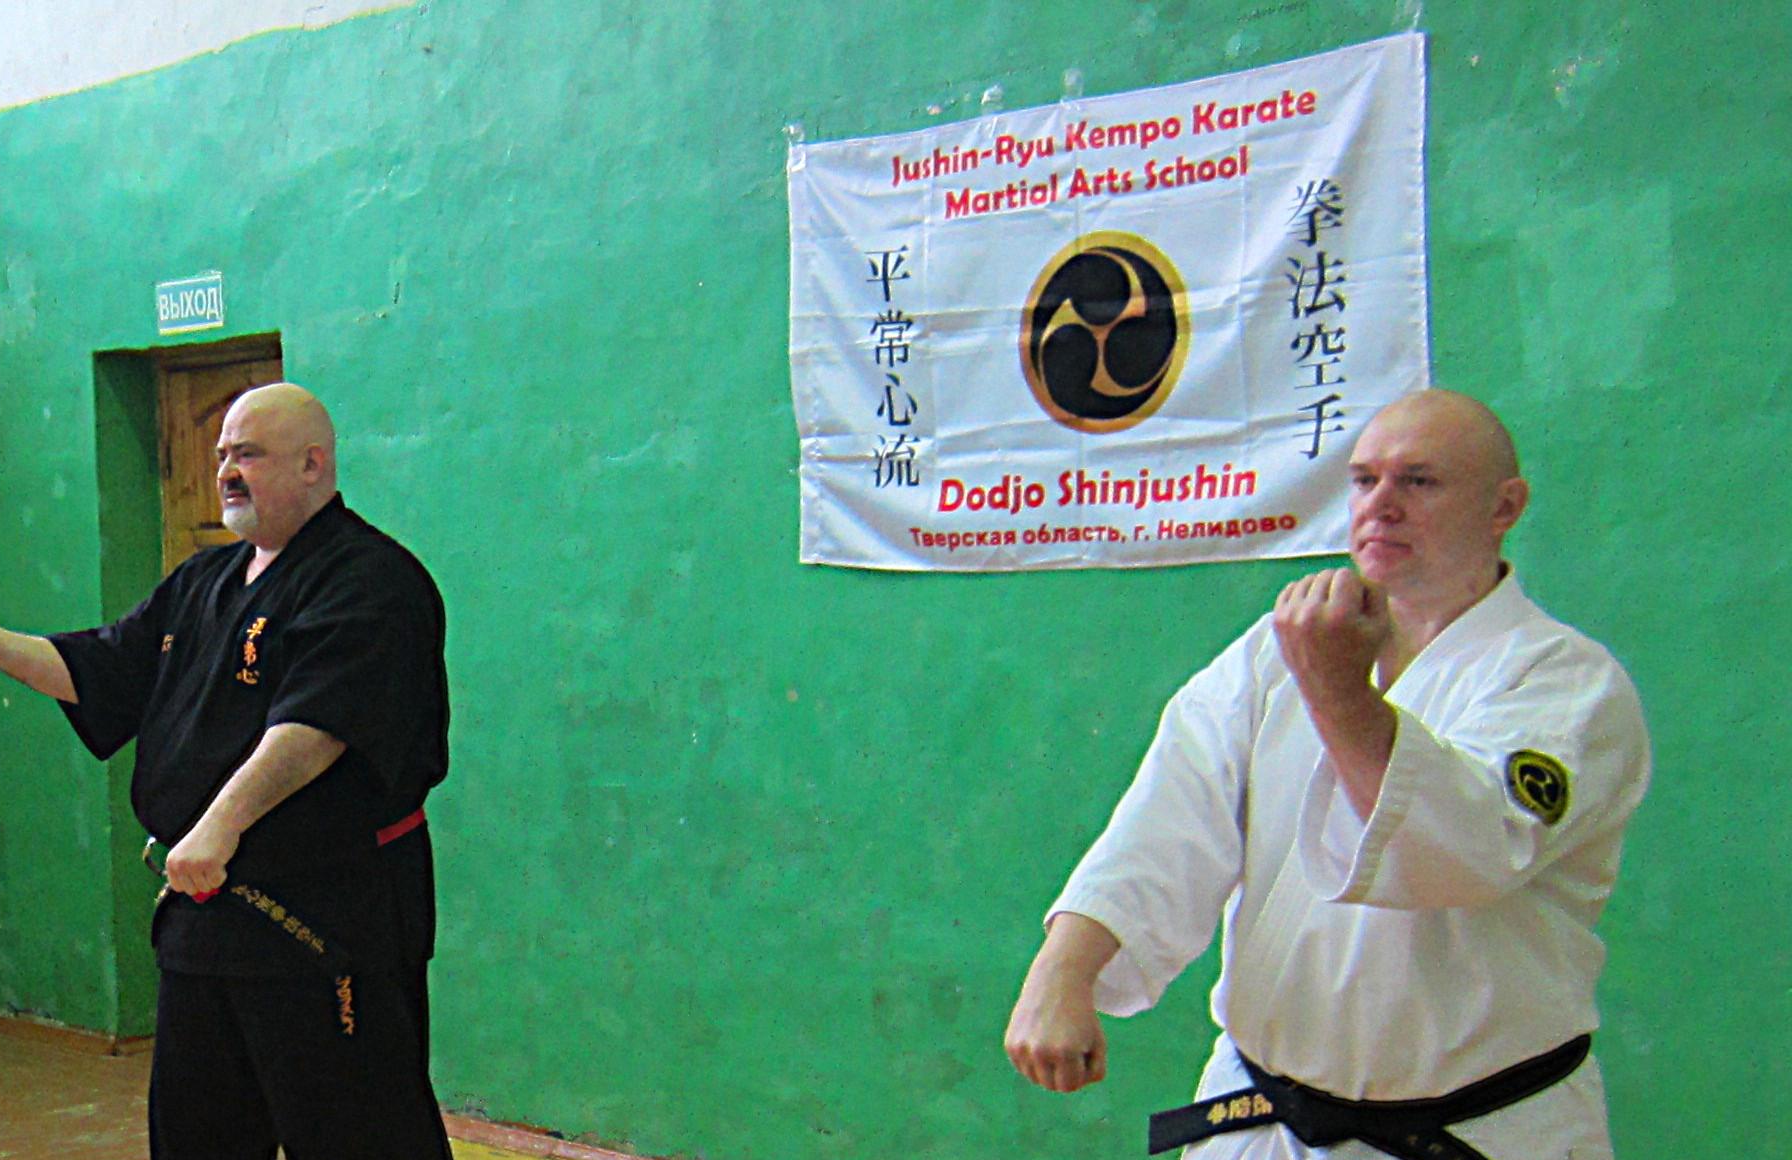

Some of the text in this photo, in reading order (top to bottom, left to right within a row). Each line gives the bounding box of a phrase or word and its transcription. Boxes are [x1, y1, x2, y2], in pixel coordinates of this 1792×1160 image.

[1064, 113, 1181, 152] Kempo
[1191, 89, 1318, 135] Karate
[944, 145, 1249, 219] Martial Arts School
[159, 287, 219, 320] ВЫХОД
[864, 244, 920, 490] 平常心流
[937, 463, 1258, 515] Dodjo Shinjushin
[909, 513, 1298, 552] Тверская область, г. Нелидово
